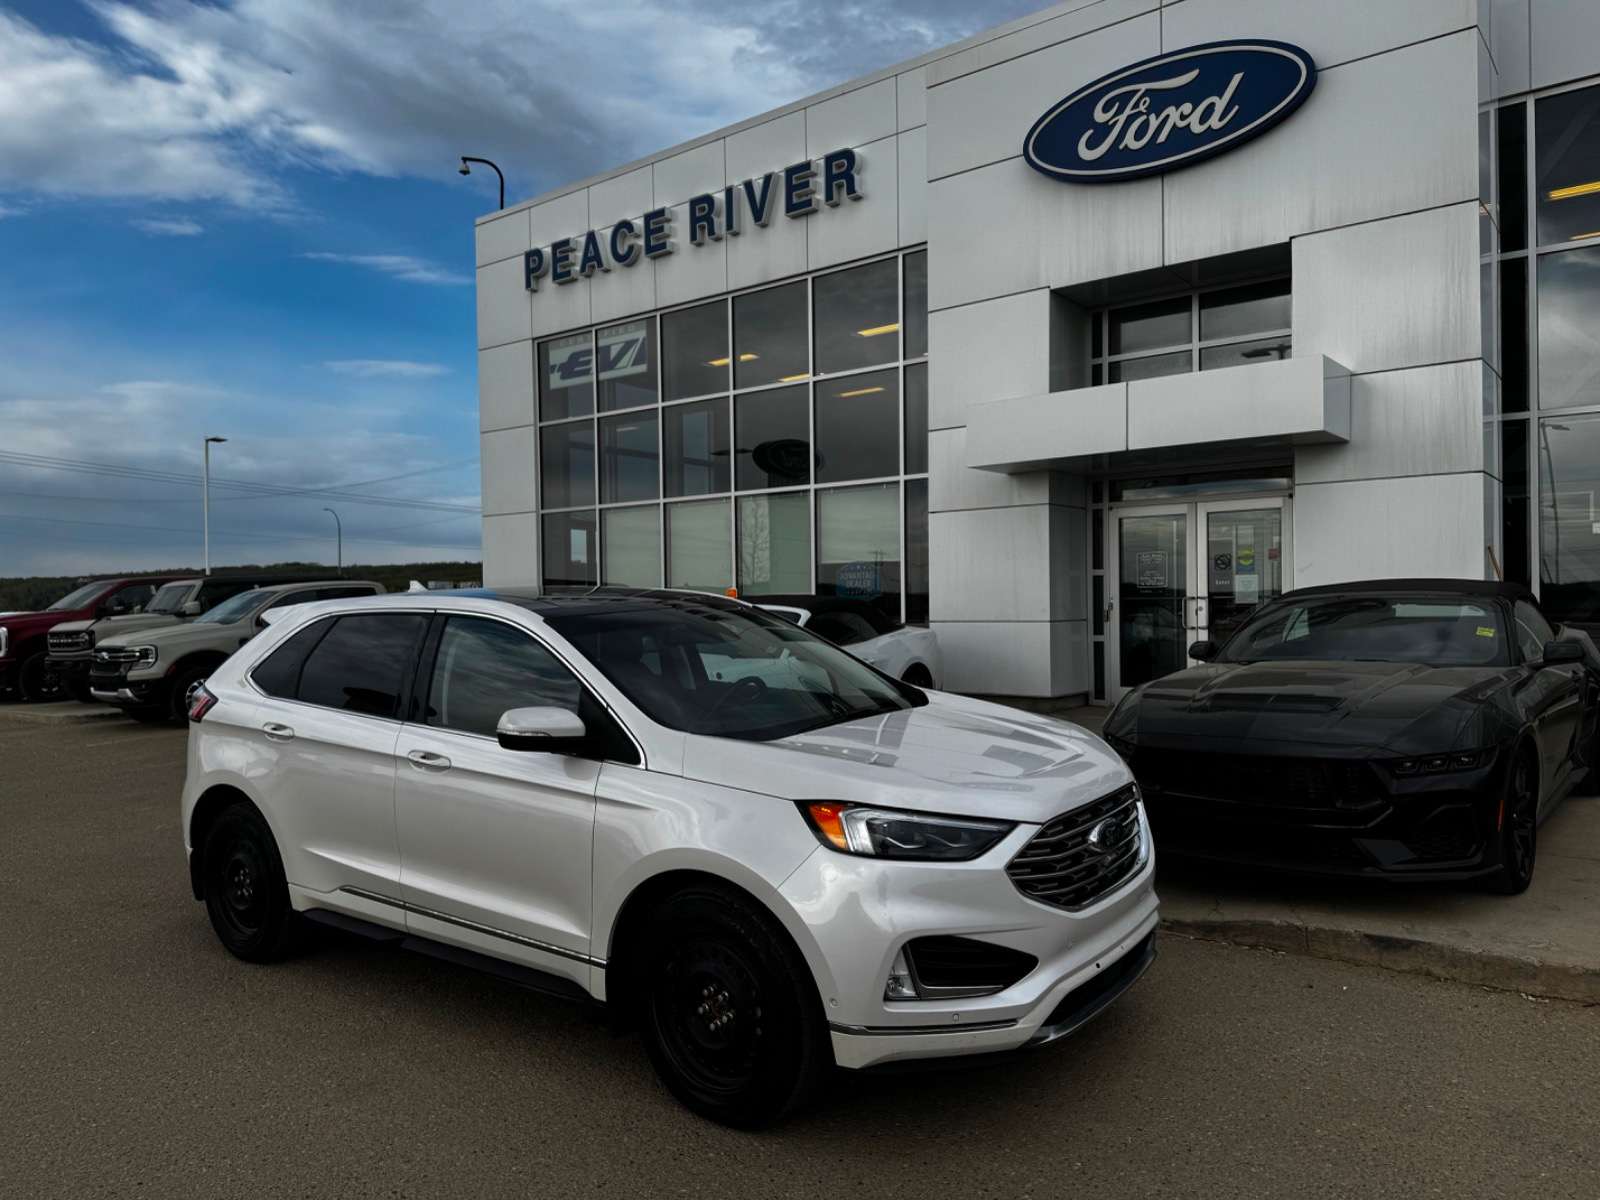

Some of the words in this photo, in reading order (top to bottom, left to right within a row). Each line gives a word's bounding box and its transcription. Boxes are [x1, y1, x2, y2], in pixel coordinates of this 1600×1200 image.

[1077, 68, 1245, 161] Ford
[524, 206, 673, 292] PEACE
[689, 147, 864, 247] RIVER
